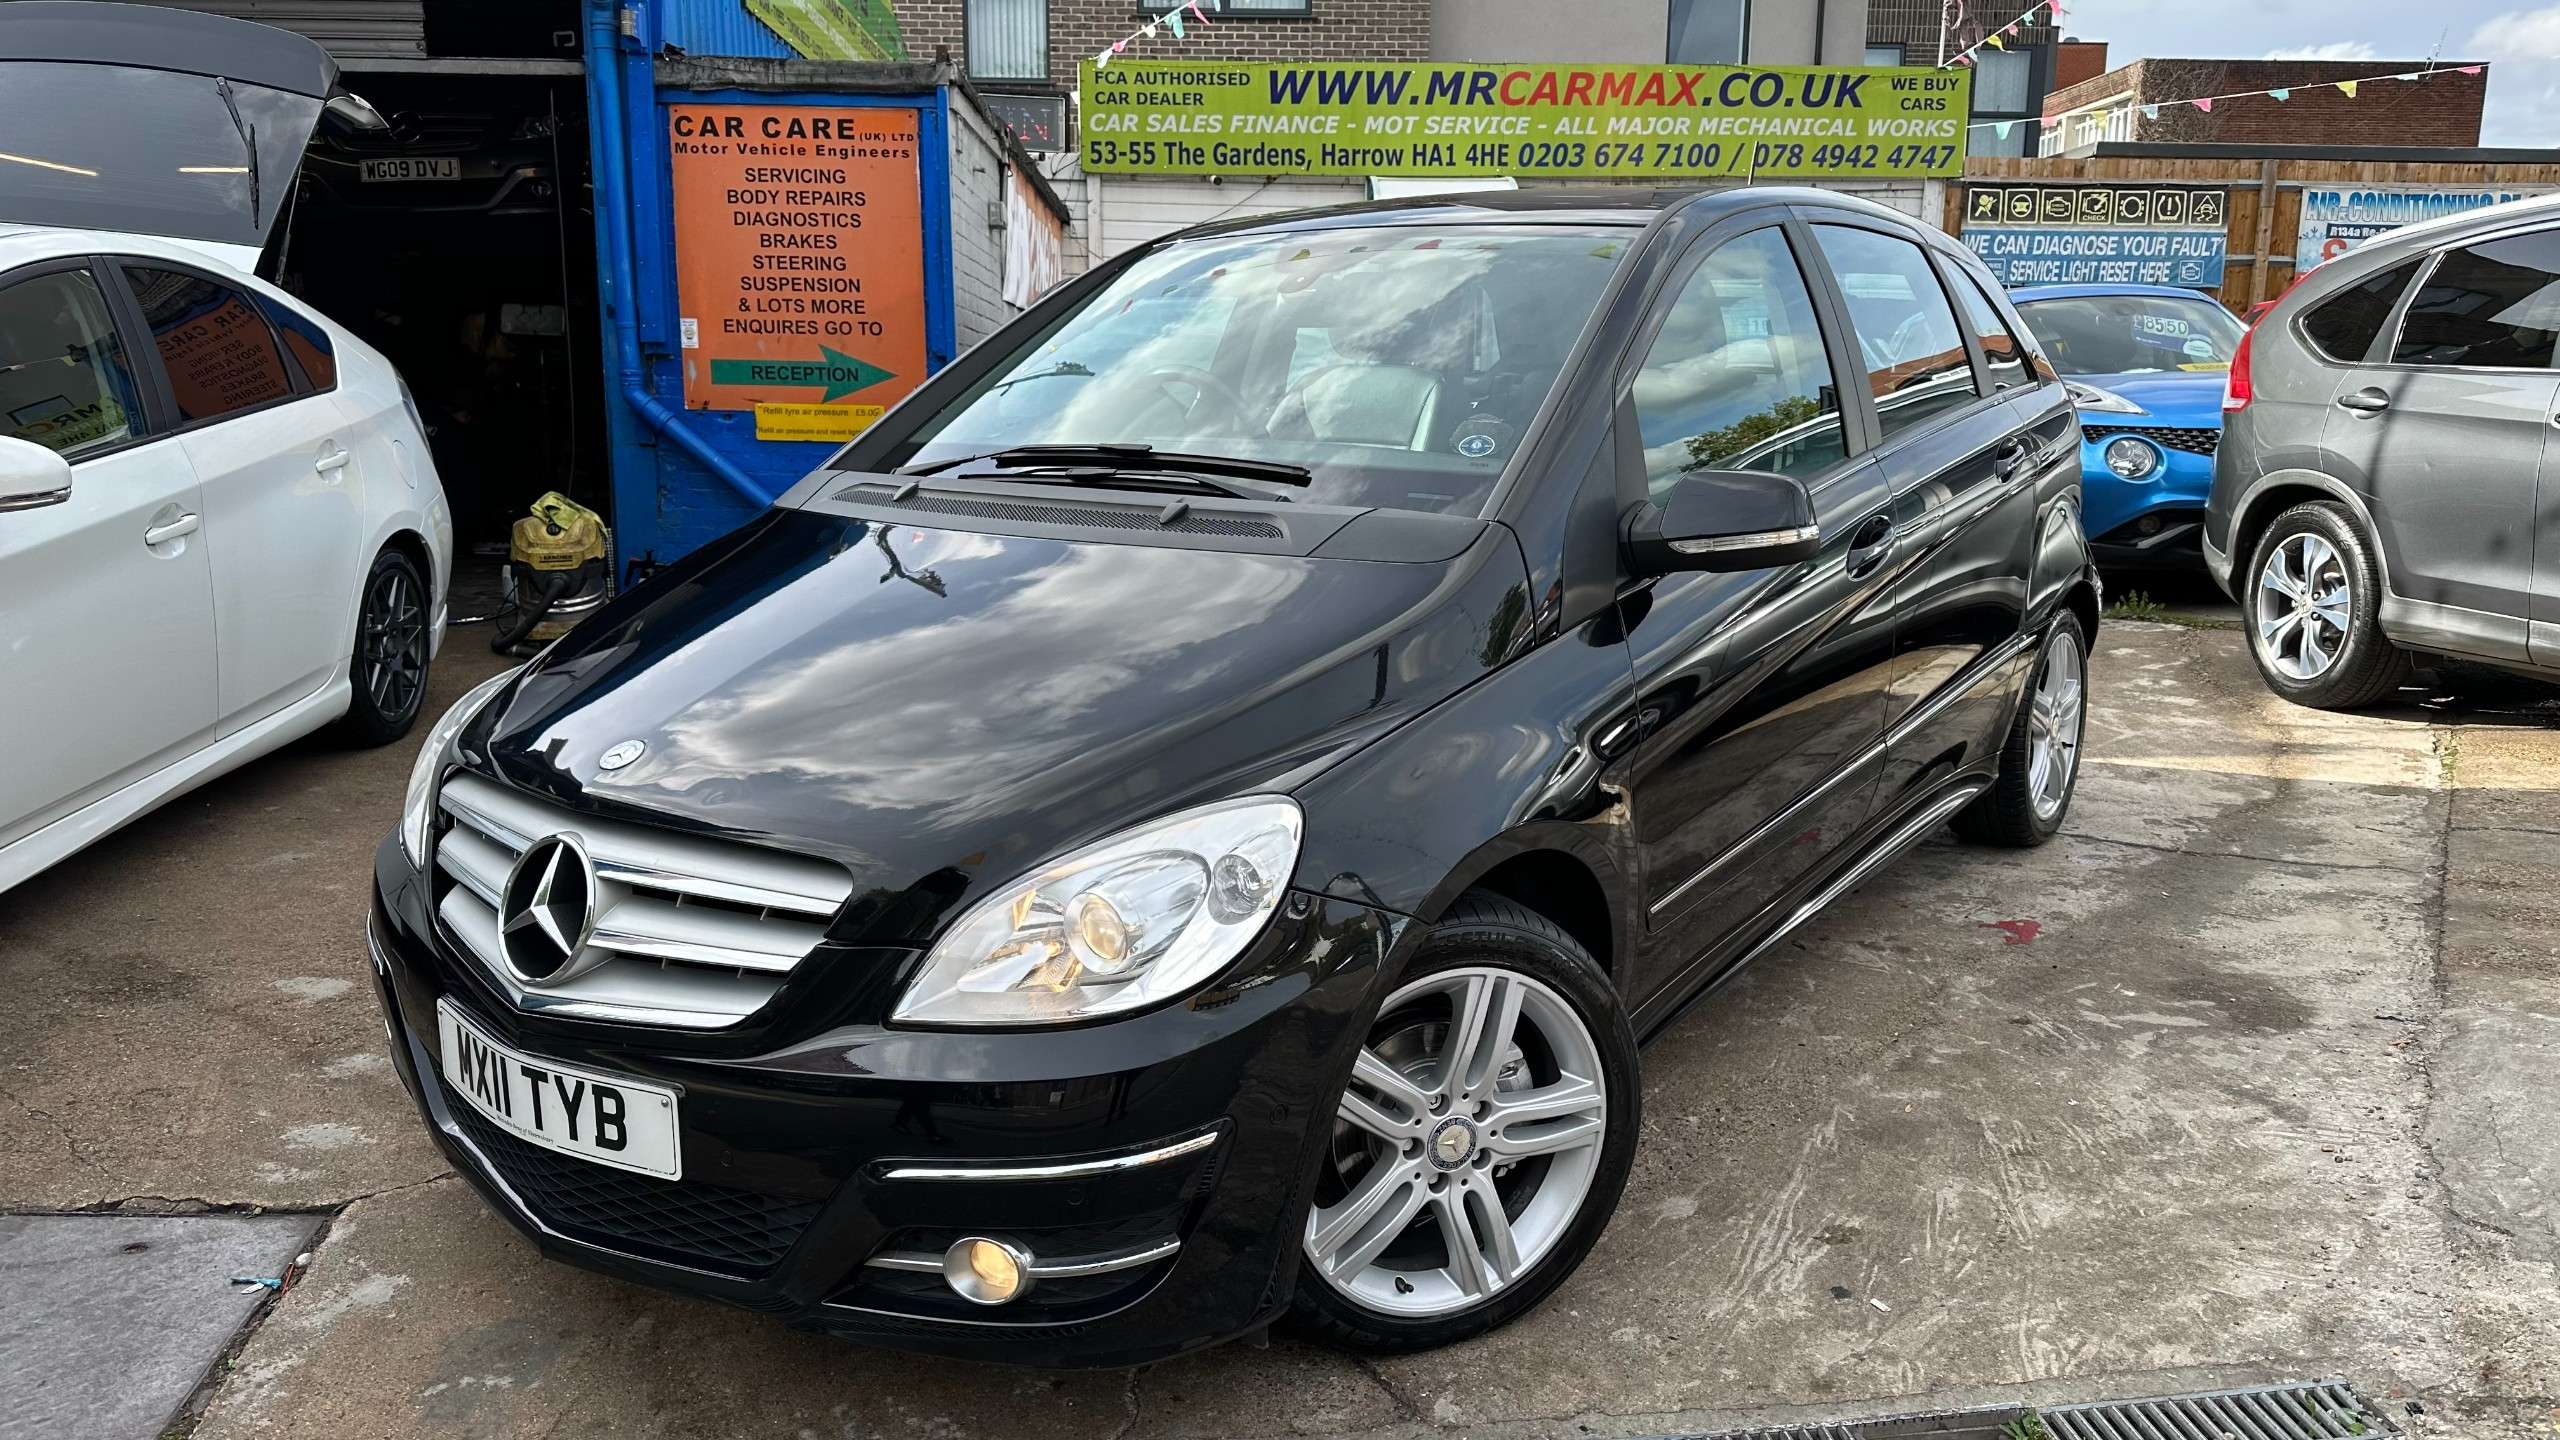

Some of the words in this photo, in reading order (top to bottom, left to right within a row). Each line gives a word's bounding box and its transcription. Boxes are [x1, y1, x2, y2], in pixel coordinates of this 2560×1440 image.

[1095, 71, 1127, 85] FCA
[1134, 71, 1250, 86] AUTHORISED
[1891, 78, 1918, 91] WE
[1924, 78, 1959, 91] BUY
[1269, 70, 1871, 108] WWW.MRCARMAX.CO.UK
[1095, 92, 1130, 105] CAR
[1136, 92, 1204, 106] DEALER
[1901, 97, 1946, 111] CARS
[674, 115, 744, 137] CAR
[762, 116, 855, 140] CARE
[859, 132, 887, 142] (UK)
[891, 133, 914, 142] LTD
[1090, 113, 1138, 132] CAR
[1146, 114, 1223, 133] SALES
[1230, 115, 1340, 134] FINANCE
[1364, 116, 1419, 134] MOT
[1424, 116, 1531, 135] SERVICE
[1554, 116, 1598, 135] ALL
[1606, 117, 1690, 136] MAJOR
[1698, 117, 1857, 137] MECHANICAL
[1867, 118, 1957, 138] WORKS
[674, 142, 728, 155] Motor
[737, 143, 806, 156] Vehicle
[816, 145, 910, 160] Engineers
[1090, 140, 1155, 165] 53-55
[1164, 142, 1205, 166] The
[1213, 142, 1313, 171] Gardens,
[1322, 143, 1404, 167] Harrow
[1412, 143, 1456, 167] HA1
[1465, 143, 1510, 167] 4HE
[1519, 142, 1586, 168] 0203
[1594, 143, 1644, 168] 674
[1653, 143, 1720, 168] 7100
[1753, 143, 1804, 168] 078
[1811, 143, 1879, 169] 4942
[1887, 144, 1956, 169] 4747
[366, 160, 410, 178] WG09
[414, 160, 453, 177] DVJ
[745, 168, 846, 184] SERVICING
[727, 189, 779, 205] BODY
[786, 191, 866, 207] REPAIRS
[734, 211, 861, 228] DIAGNOSTICS
[2330, 226, 2360, 237] R134a
[760, 234, 837, 249] BRAKES
[1964, 234, 1990, 254] WE
[1994, 235, 2028, 255] CAN
[2032, 235, 2119, 256] DIAGNOSE
[2123, 236, 2166, 256] YOUR
[2171, 236, 2220, 257] FAULT
[753, 255, 847, 271] STEERING
[2010, 259, 2060, 281] SERVICE
[2061, 260, 2098, 282] LIGHT
[2098, 261, 2138, 282] RESET
[2138, 261, 2172, 282] HERE
[741, 276, 860, 293] SUSPENSION
[738, 298, 751, 312] &
[757, 298, 805, 313] LOTS
[811, 299, 865, 314] MORE
[723, 318, 818, 335] ENQUIRES
[825, 321, 853, 335] GO
[858, 321, 883, 336] TO
[751, 365, 859, 382] RECEPTION
[456, 1023, 511, 1118] MX11
[520, 1065, 628, 1152] TYB
